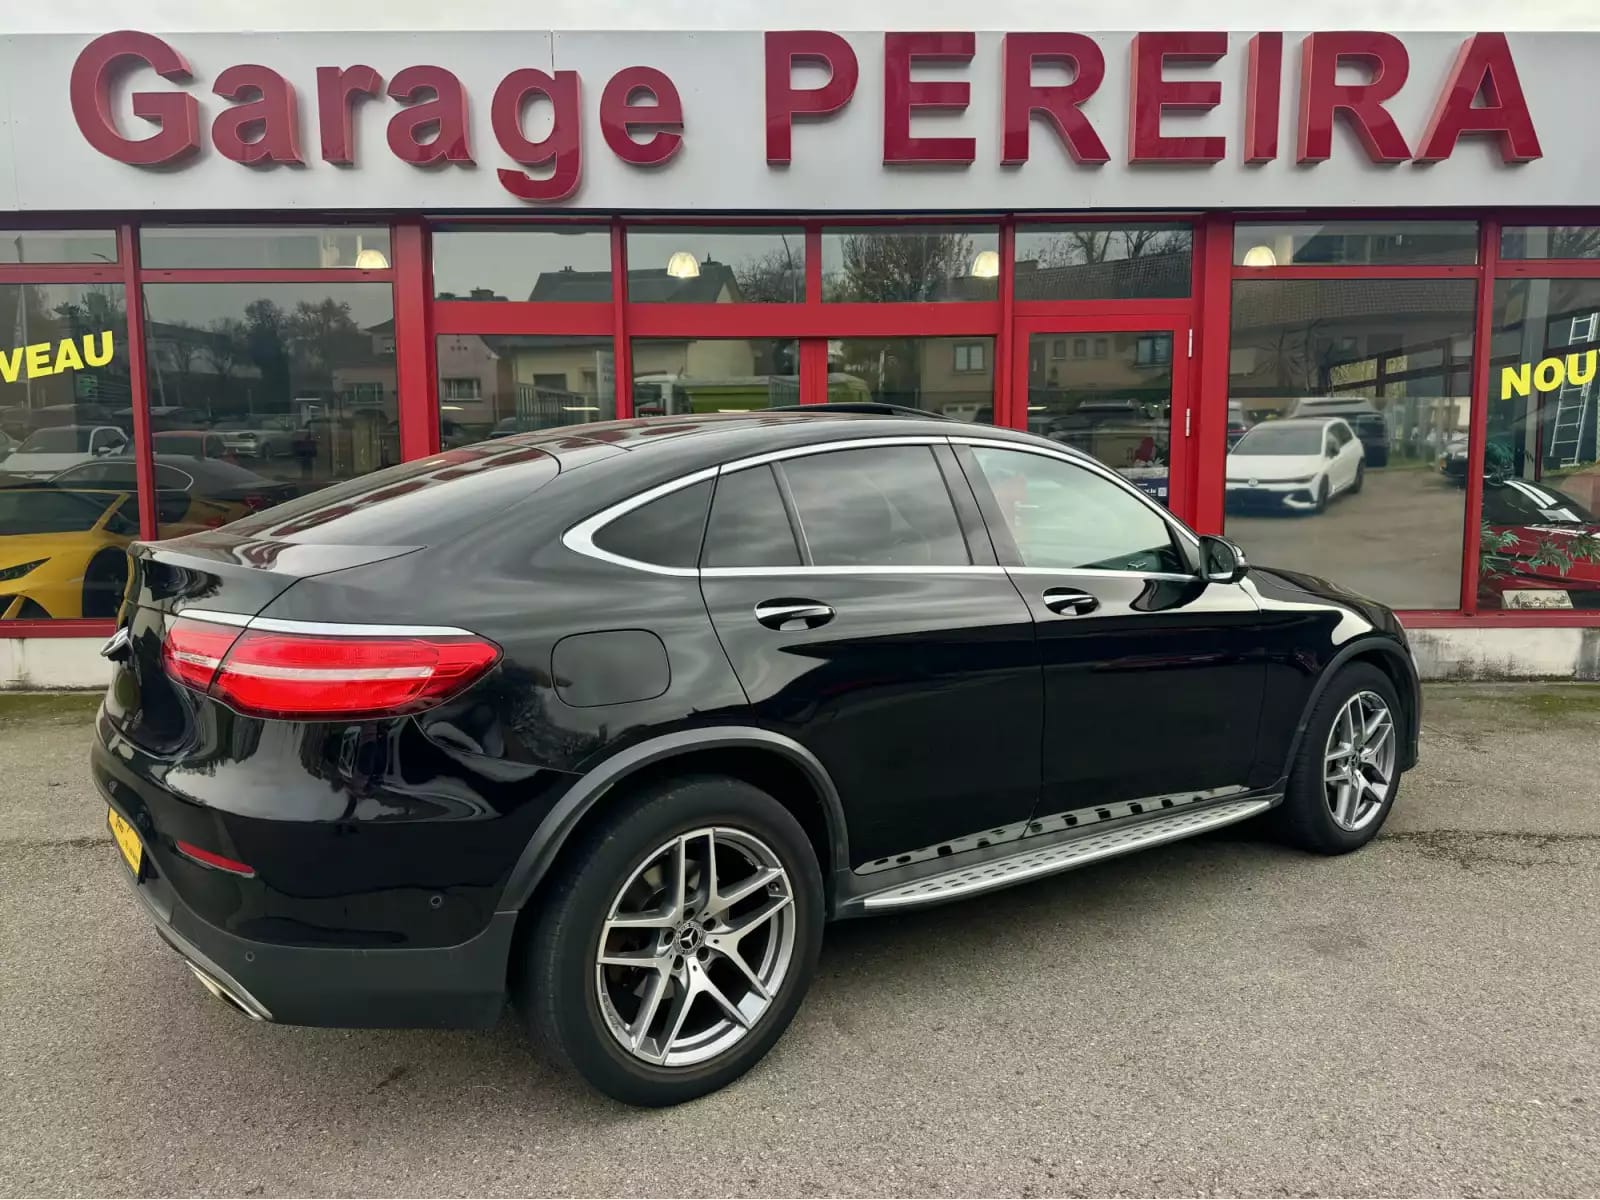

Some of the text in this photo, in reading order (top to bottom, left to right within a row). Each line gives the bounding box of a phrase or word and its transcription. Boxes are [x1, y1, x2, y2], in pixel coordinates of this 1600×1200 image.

[70, 30, 1543, 202] Garage PEREIRA
[0, 330, 114, 383] VEAU
[1501, 349, 1600, 400] NOU
